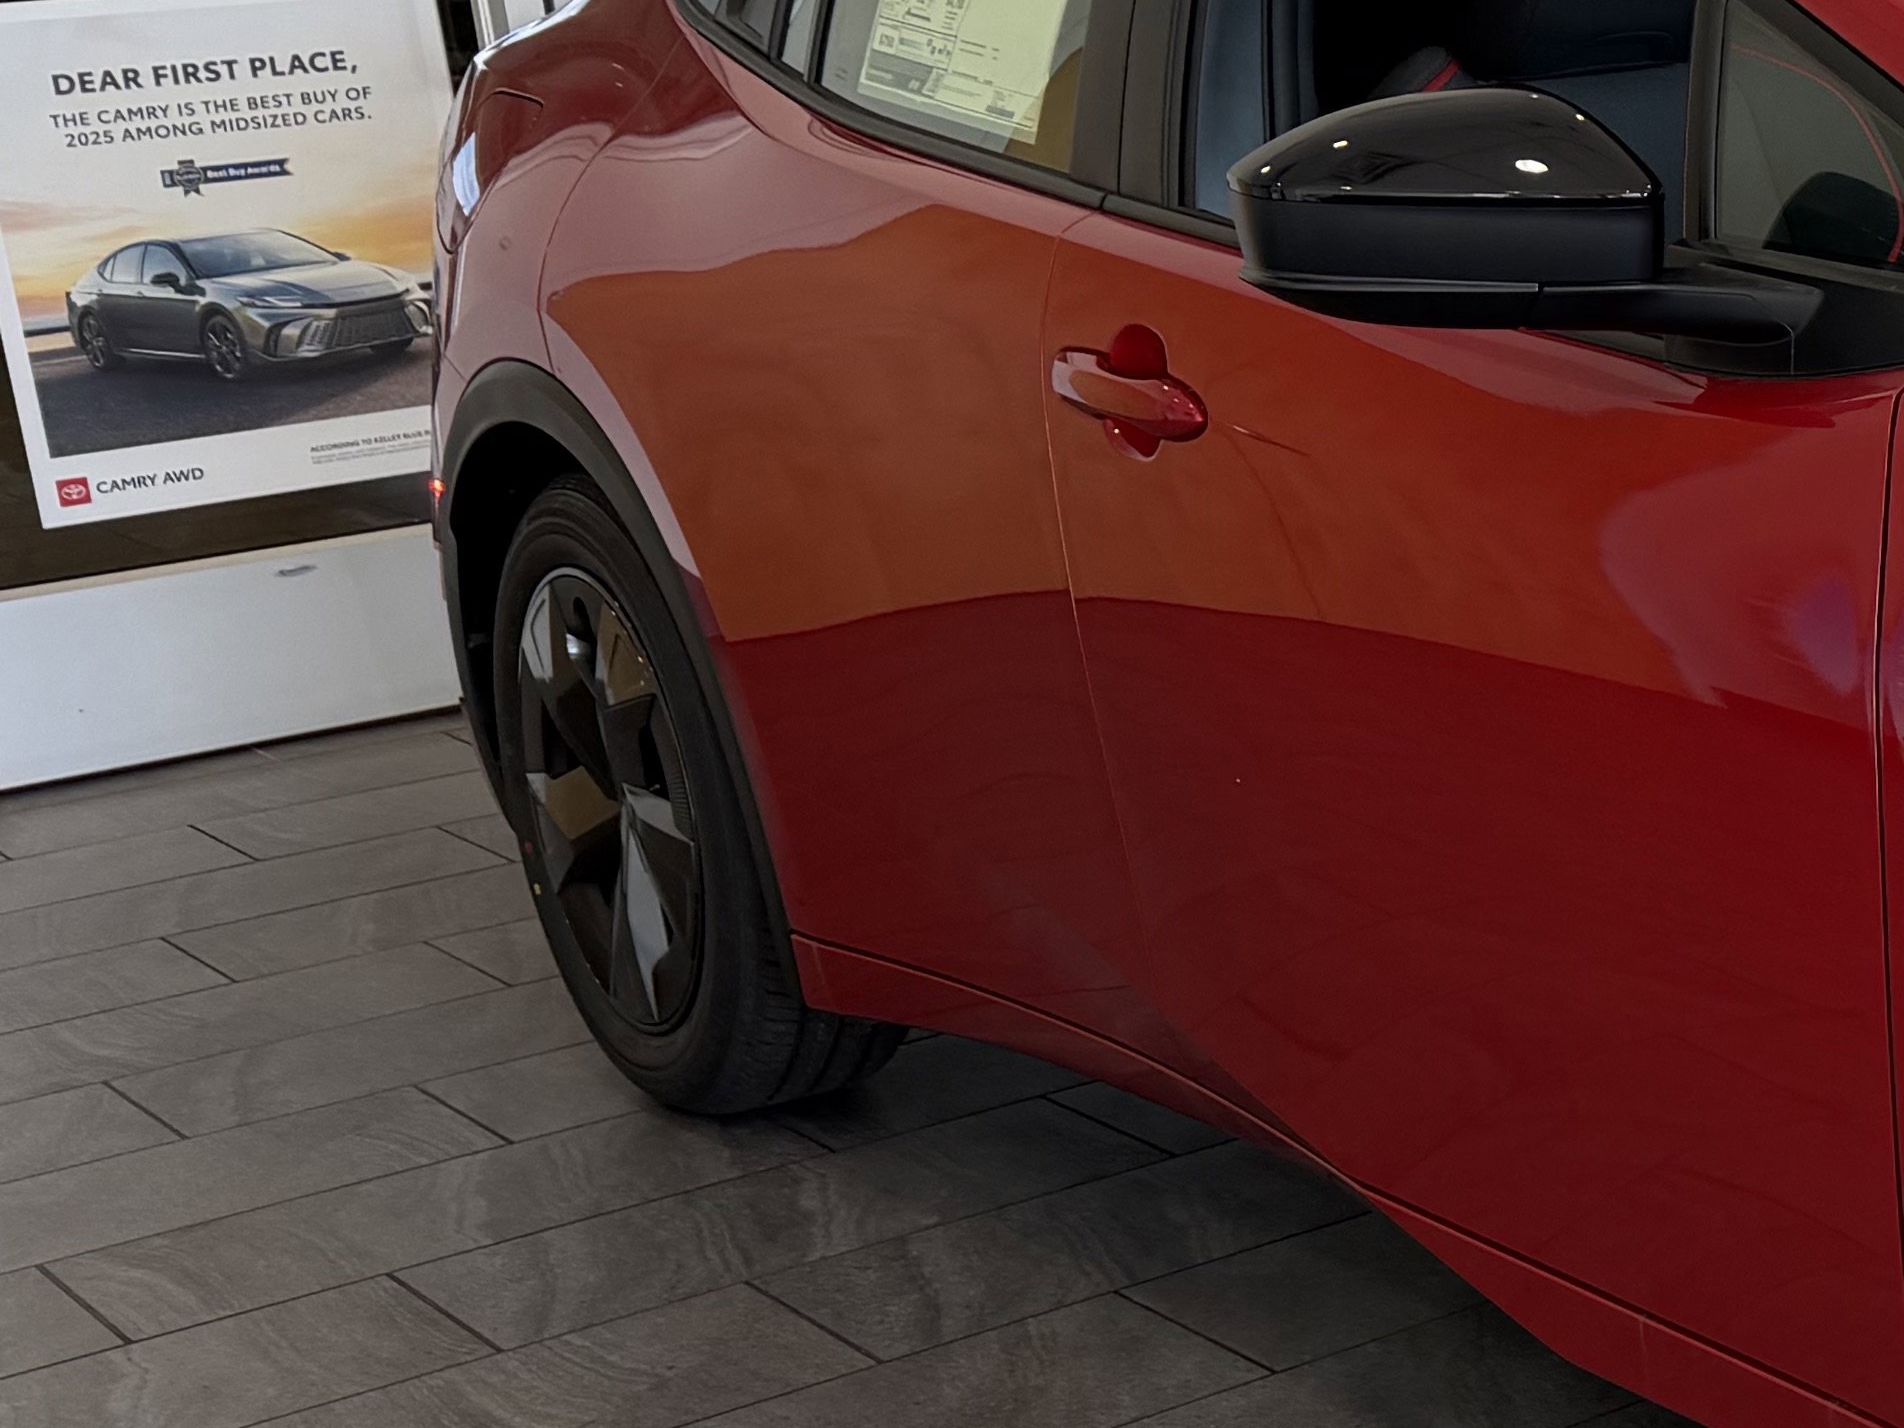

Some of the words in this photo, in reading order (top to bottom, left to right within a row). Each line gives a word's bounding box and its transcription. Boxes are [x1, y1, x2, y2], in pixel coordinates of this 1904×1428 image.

[51, 68, 144, 95] DEAR
[152, 60, 239, 87] FIRST
[248, 50, 358, 78] PLACE,
[49, 112, 92, 129] THE
[98, 105, 170, 125] CAMRY
[177, 102, 196, 117] IS
[200, 98, 240, 114] THE
[247, 93, 293, 111] BEST
[300, 89, 338, 106] BUY
[345, 86, 372, 100] OF
[64, 132, 115, 148] 2025
[122, 122, 204, 143] AMONG
[211, 112, 308, 134] MIDSIZED
[314, 106, 372, 123] CARS.
[96, 474, 157, 494] CAMRY
[163, 467, 204, 485] AWD
